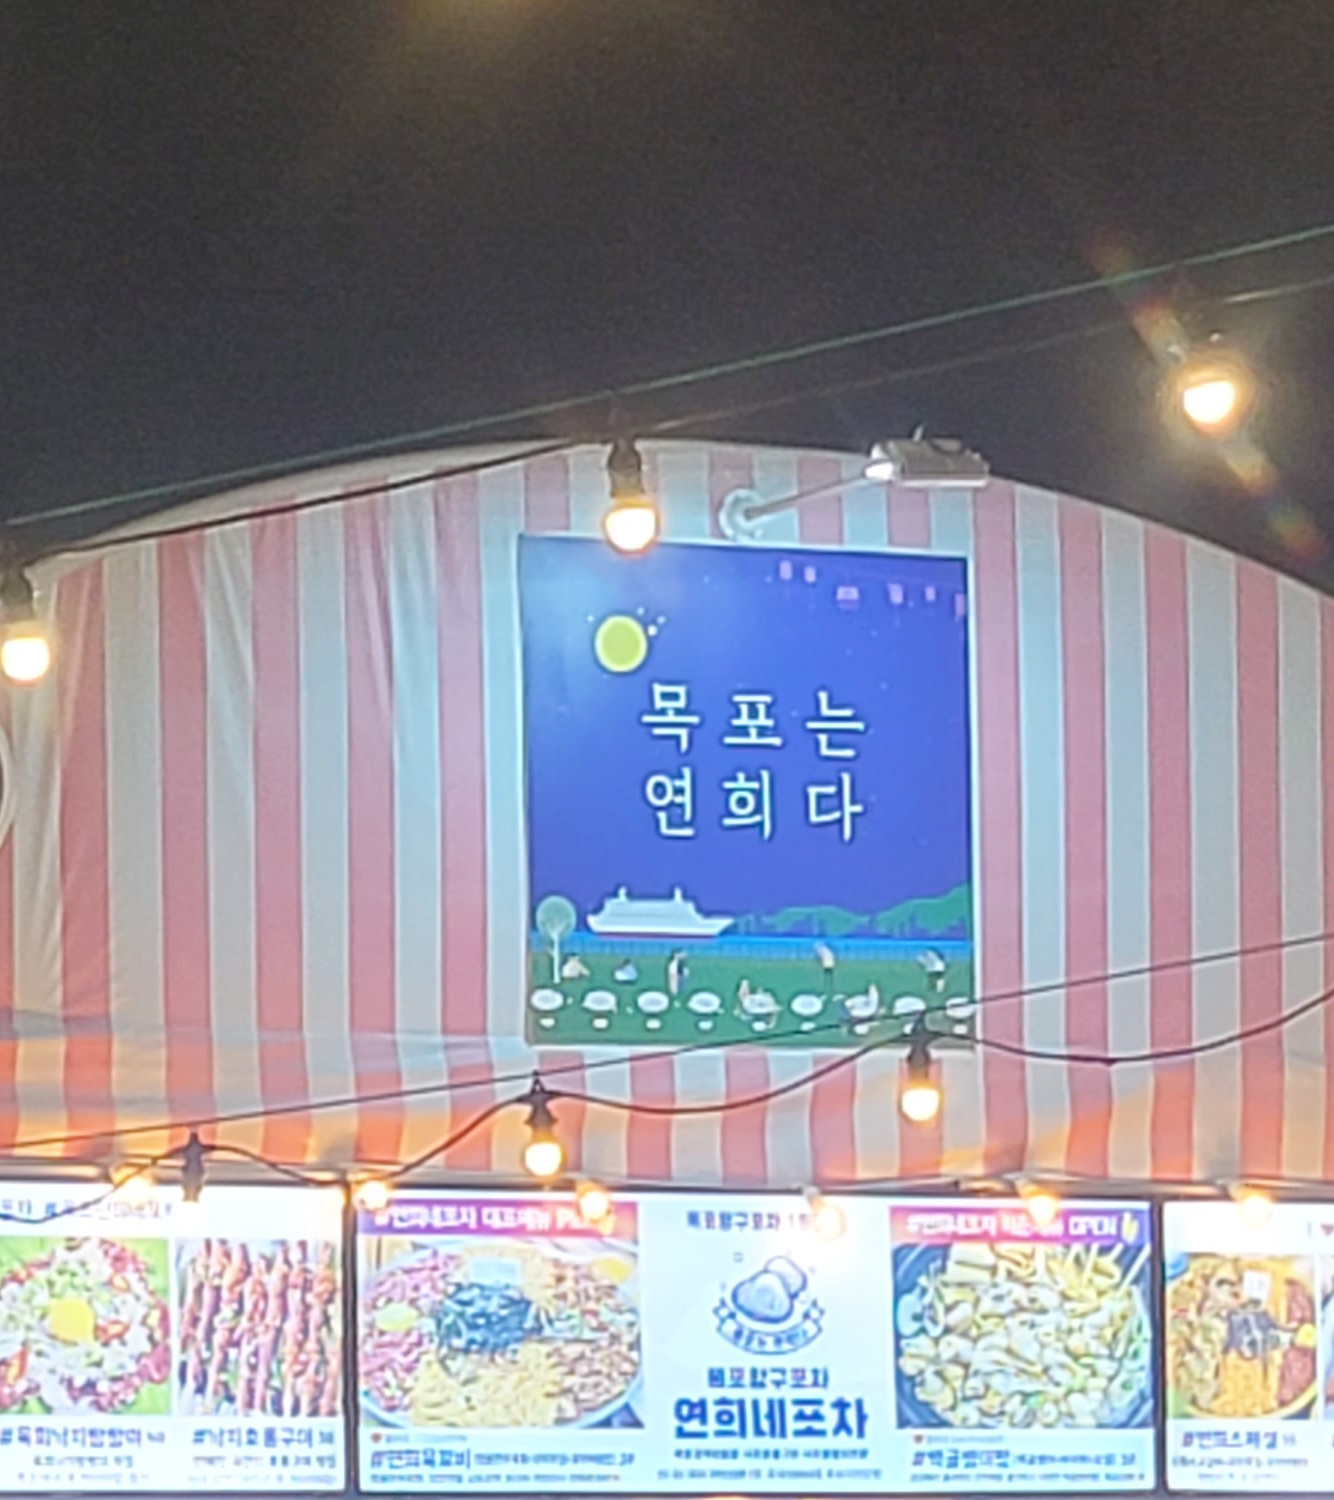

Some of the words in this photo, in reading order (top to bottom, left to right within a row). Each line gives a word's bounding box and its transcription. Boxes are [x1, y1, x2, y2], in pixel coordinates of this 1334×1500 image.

[639, 681, 868, 760] 목포는
[643, 766, 865, 843] 연희다
[673, 1396, 869, 1440] 연희네포차
